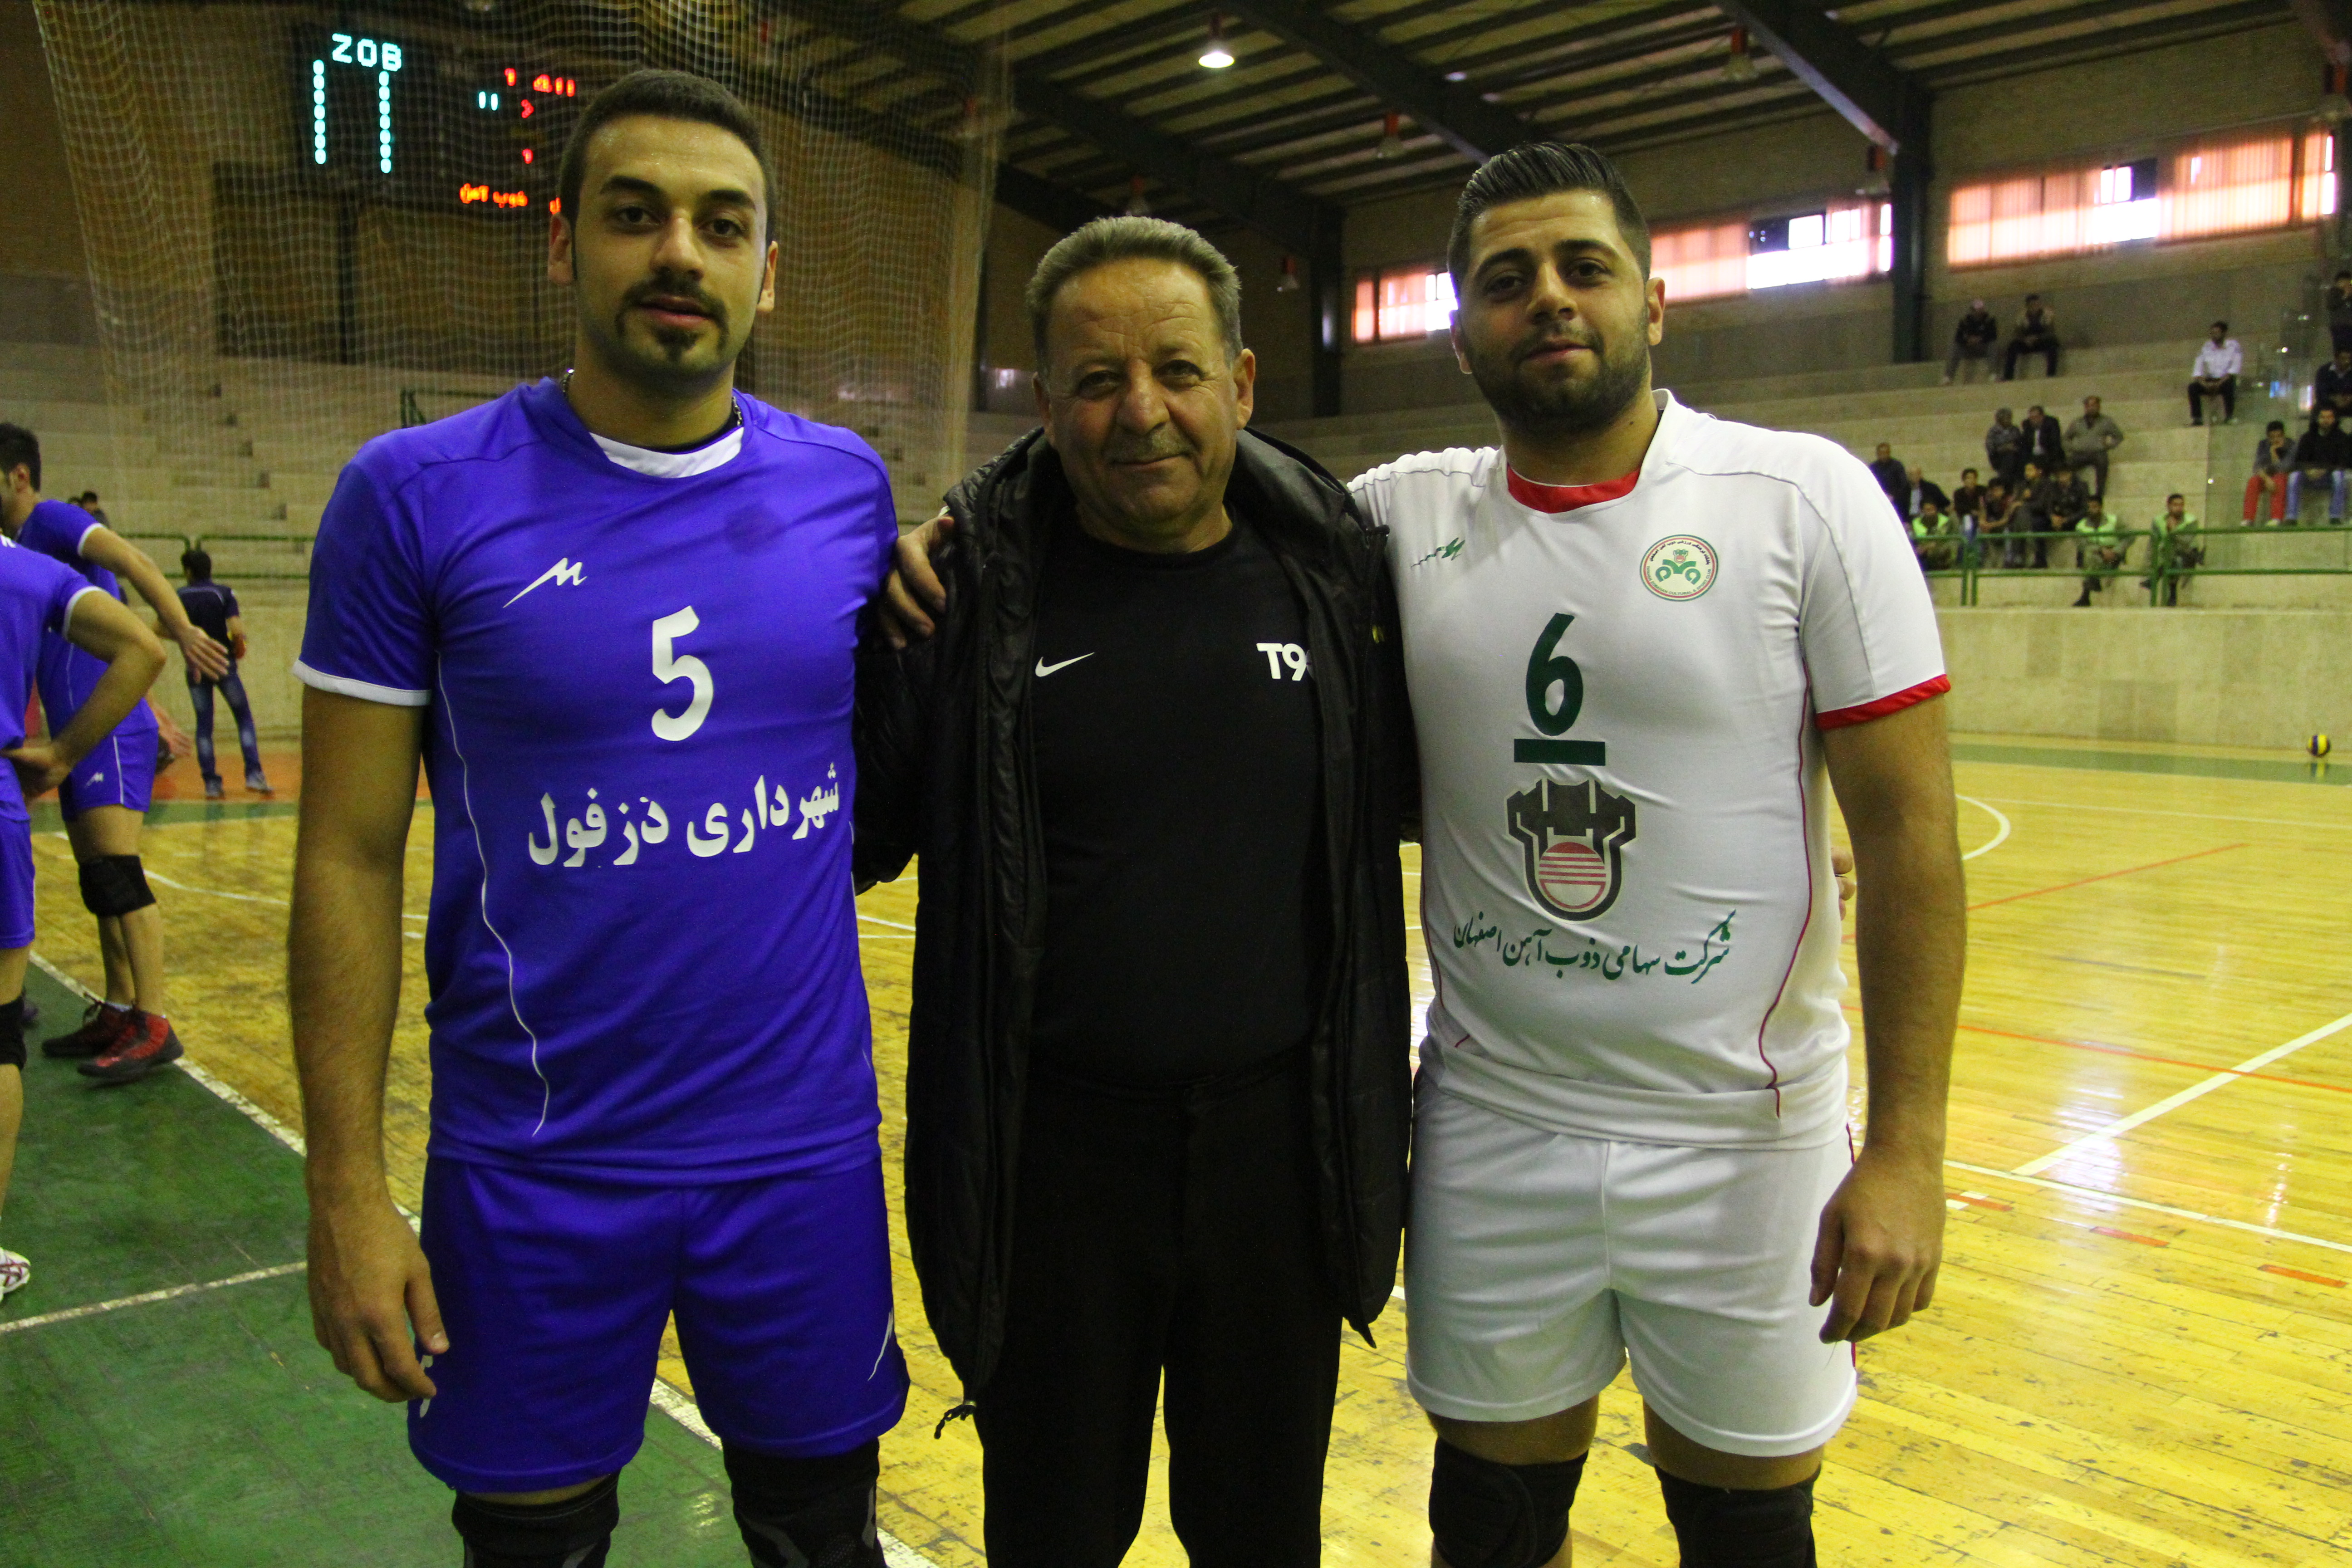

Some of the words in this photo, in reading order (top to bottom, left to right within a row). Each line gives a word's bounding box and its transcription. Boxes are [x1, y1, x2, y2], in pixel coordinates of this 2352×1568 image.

[332, 33, 402, 71] ZOB
[651, 605, 714, 741] 5
[1525, 612, 1583, 736] 6
[528, 787, 669, 867] دزفول
[686, 762, 839, 858] شهرداری
[1453, 911, 1502, 952] اصفهان
[1545, 937, 1601, 979] ذوب
[1602, 944, 1661, 981] سهامی
[1664, 909, 1736, 984] شرکت
